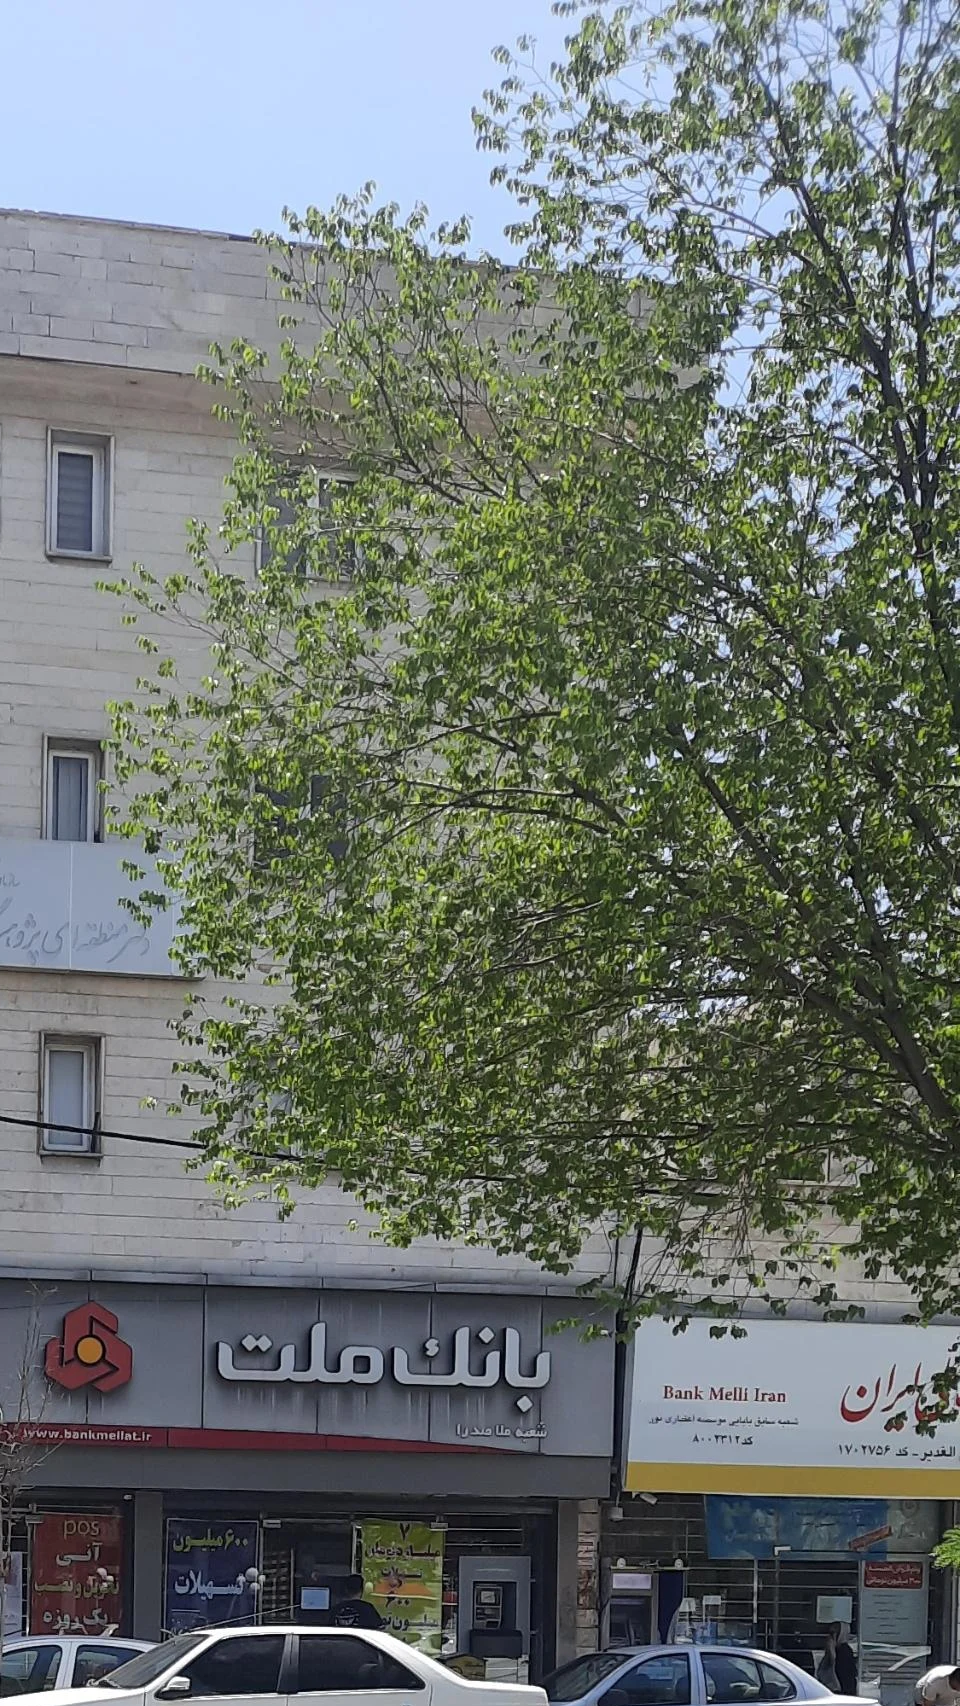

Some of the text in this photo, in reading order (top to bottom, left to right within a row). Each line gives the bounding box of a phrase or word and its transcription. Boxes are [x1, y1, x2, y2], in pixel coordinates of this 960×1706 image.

[217, 1321, 385, 1384] ملت
[663, 1385, 787, 1403] Bank Melli Iran
[23, 1428, 152, 1442] www.bankmellat.ir
[515, 1421, 548, 1443] شعبه
[64, 1519, 101, 1540] pos
[173, 1528, 224, 1552] میلیون
[56, 1541, 104, 1566] آنی
